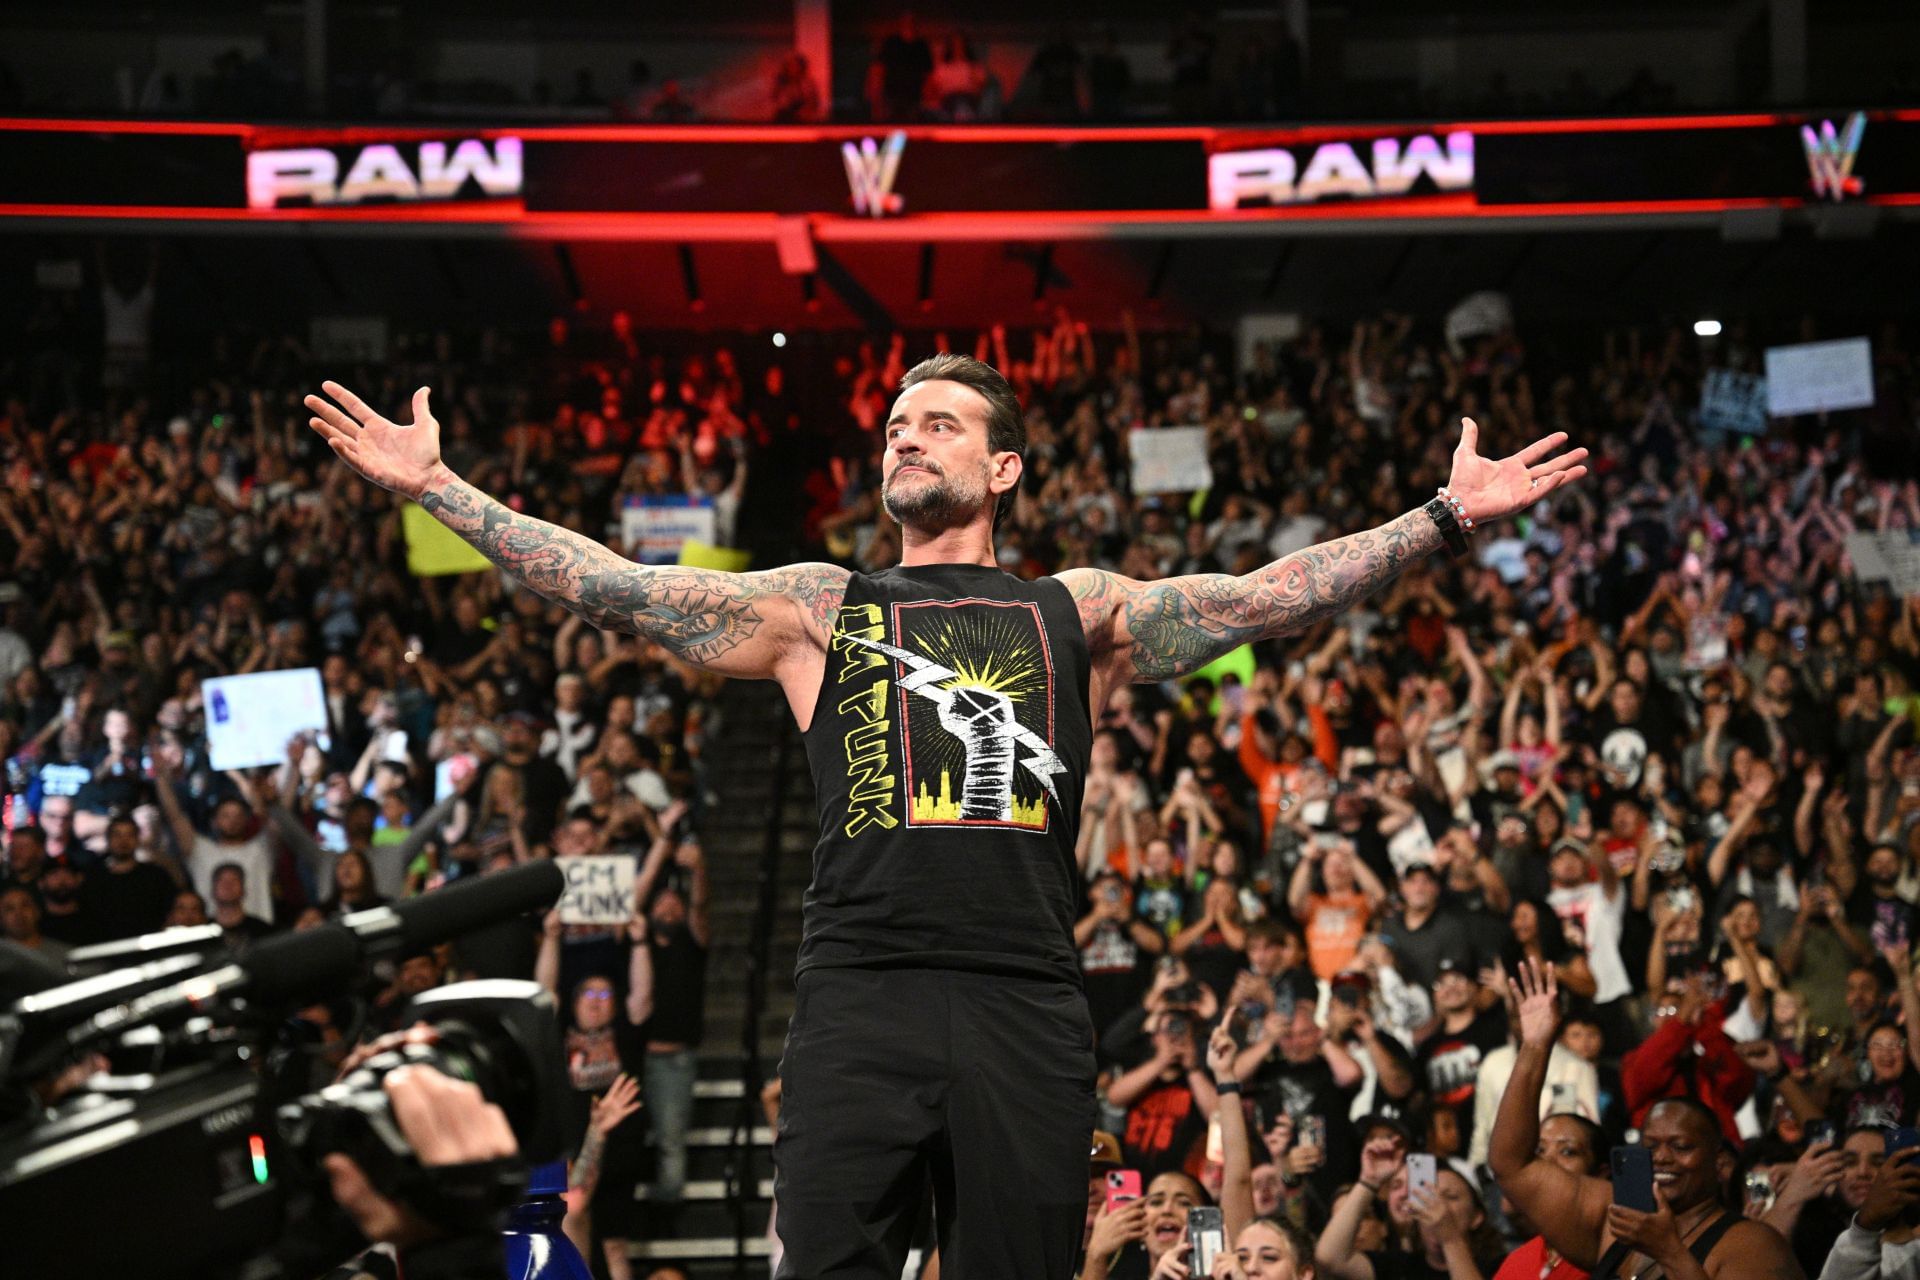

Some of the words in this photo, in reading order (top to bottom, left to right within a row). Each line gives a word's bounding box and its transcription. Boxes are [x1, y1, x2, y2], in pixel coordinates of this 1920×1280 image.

[247, 137, 523, 209] RAW
[1208, 129, 1474, 208] RAW
[833, 603, 888, 684] CM
[838, 679, 899, 839] PUNK
[560, 889, 633, 916] PUNK
[566, 861, 615, 885] CM
